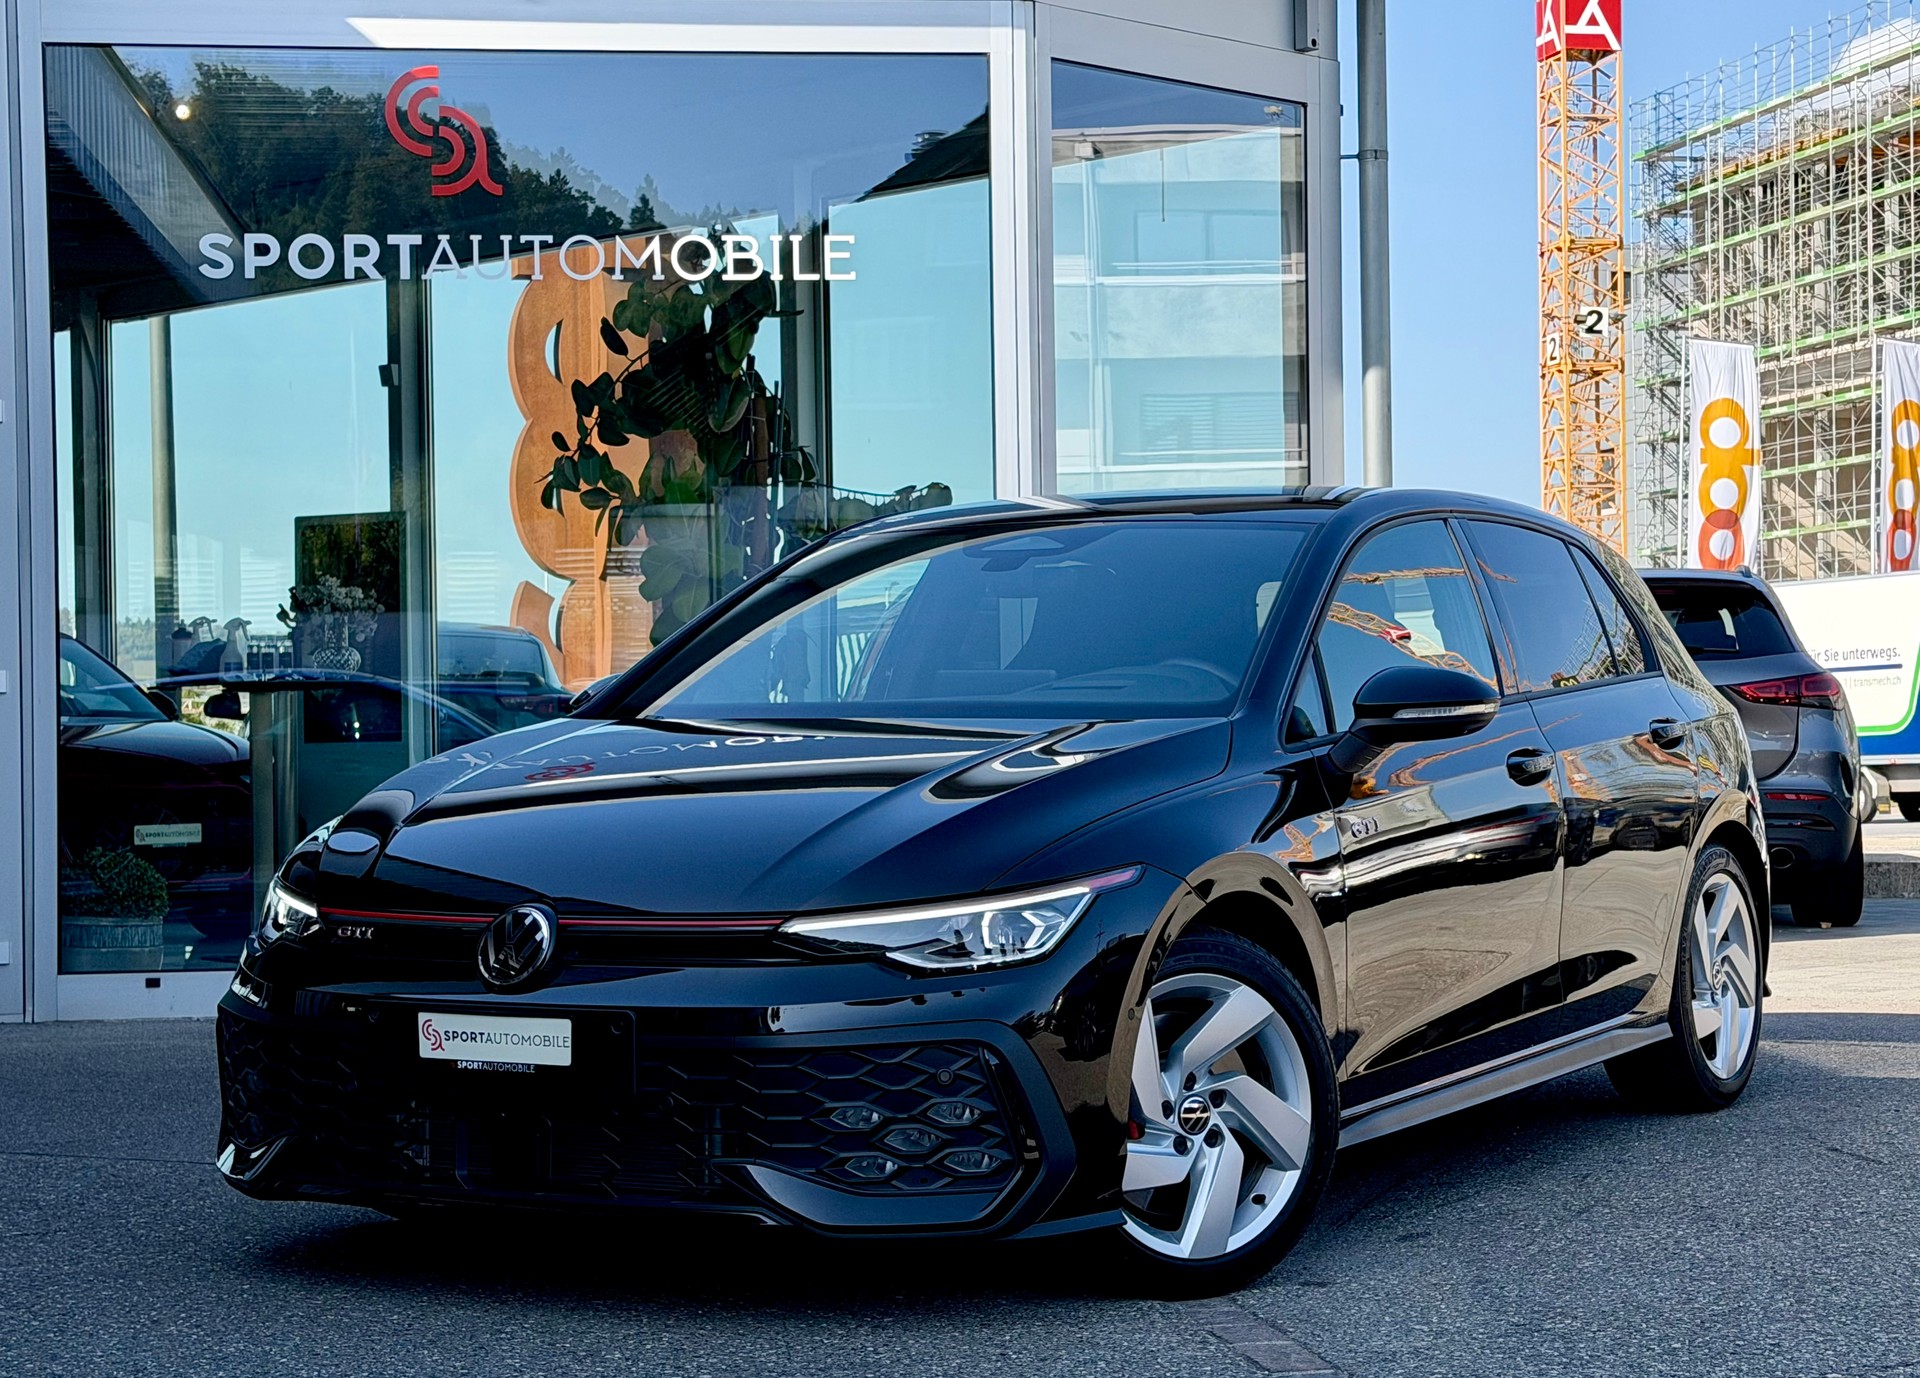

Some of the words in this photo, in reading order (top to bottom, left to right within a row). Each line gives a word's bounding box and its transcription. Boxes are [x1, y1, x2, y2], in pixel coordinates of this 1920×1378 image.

[198, 232, 857, 281] SPORTAUTOMOBILE
[1585, 310, 1603, 334] 2
[1549, 337, 1557, 361] 2
[1824, 648, 1840, 662] Sie
[1842, 647, 1901, 661] unterwegs.
[337, 925, 374, 940] GTI
[444, 1030, 570, 1049] SPORTAUTOMOBILE
[457, 1060, 536, 1073] SPORTAUTOMOBILE
